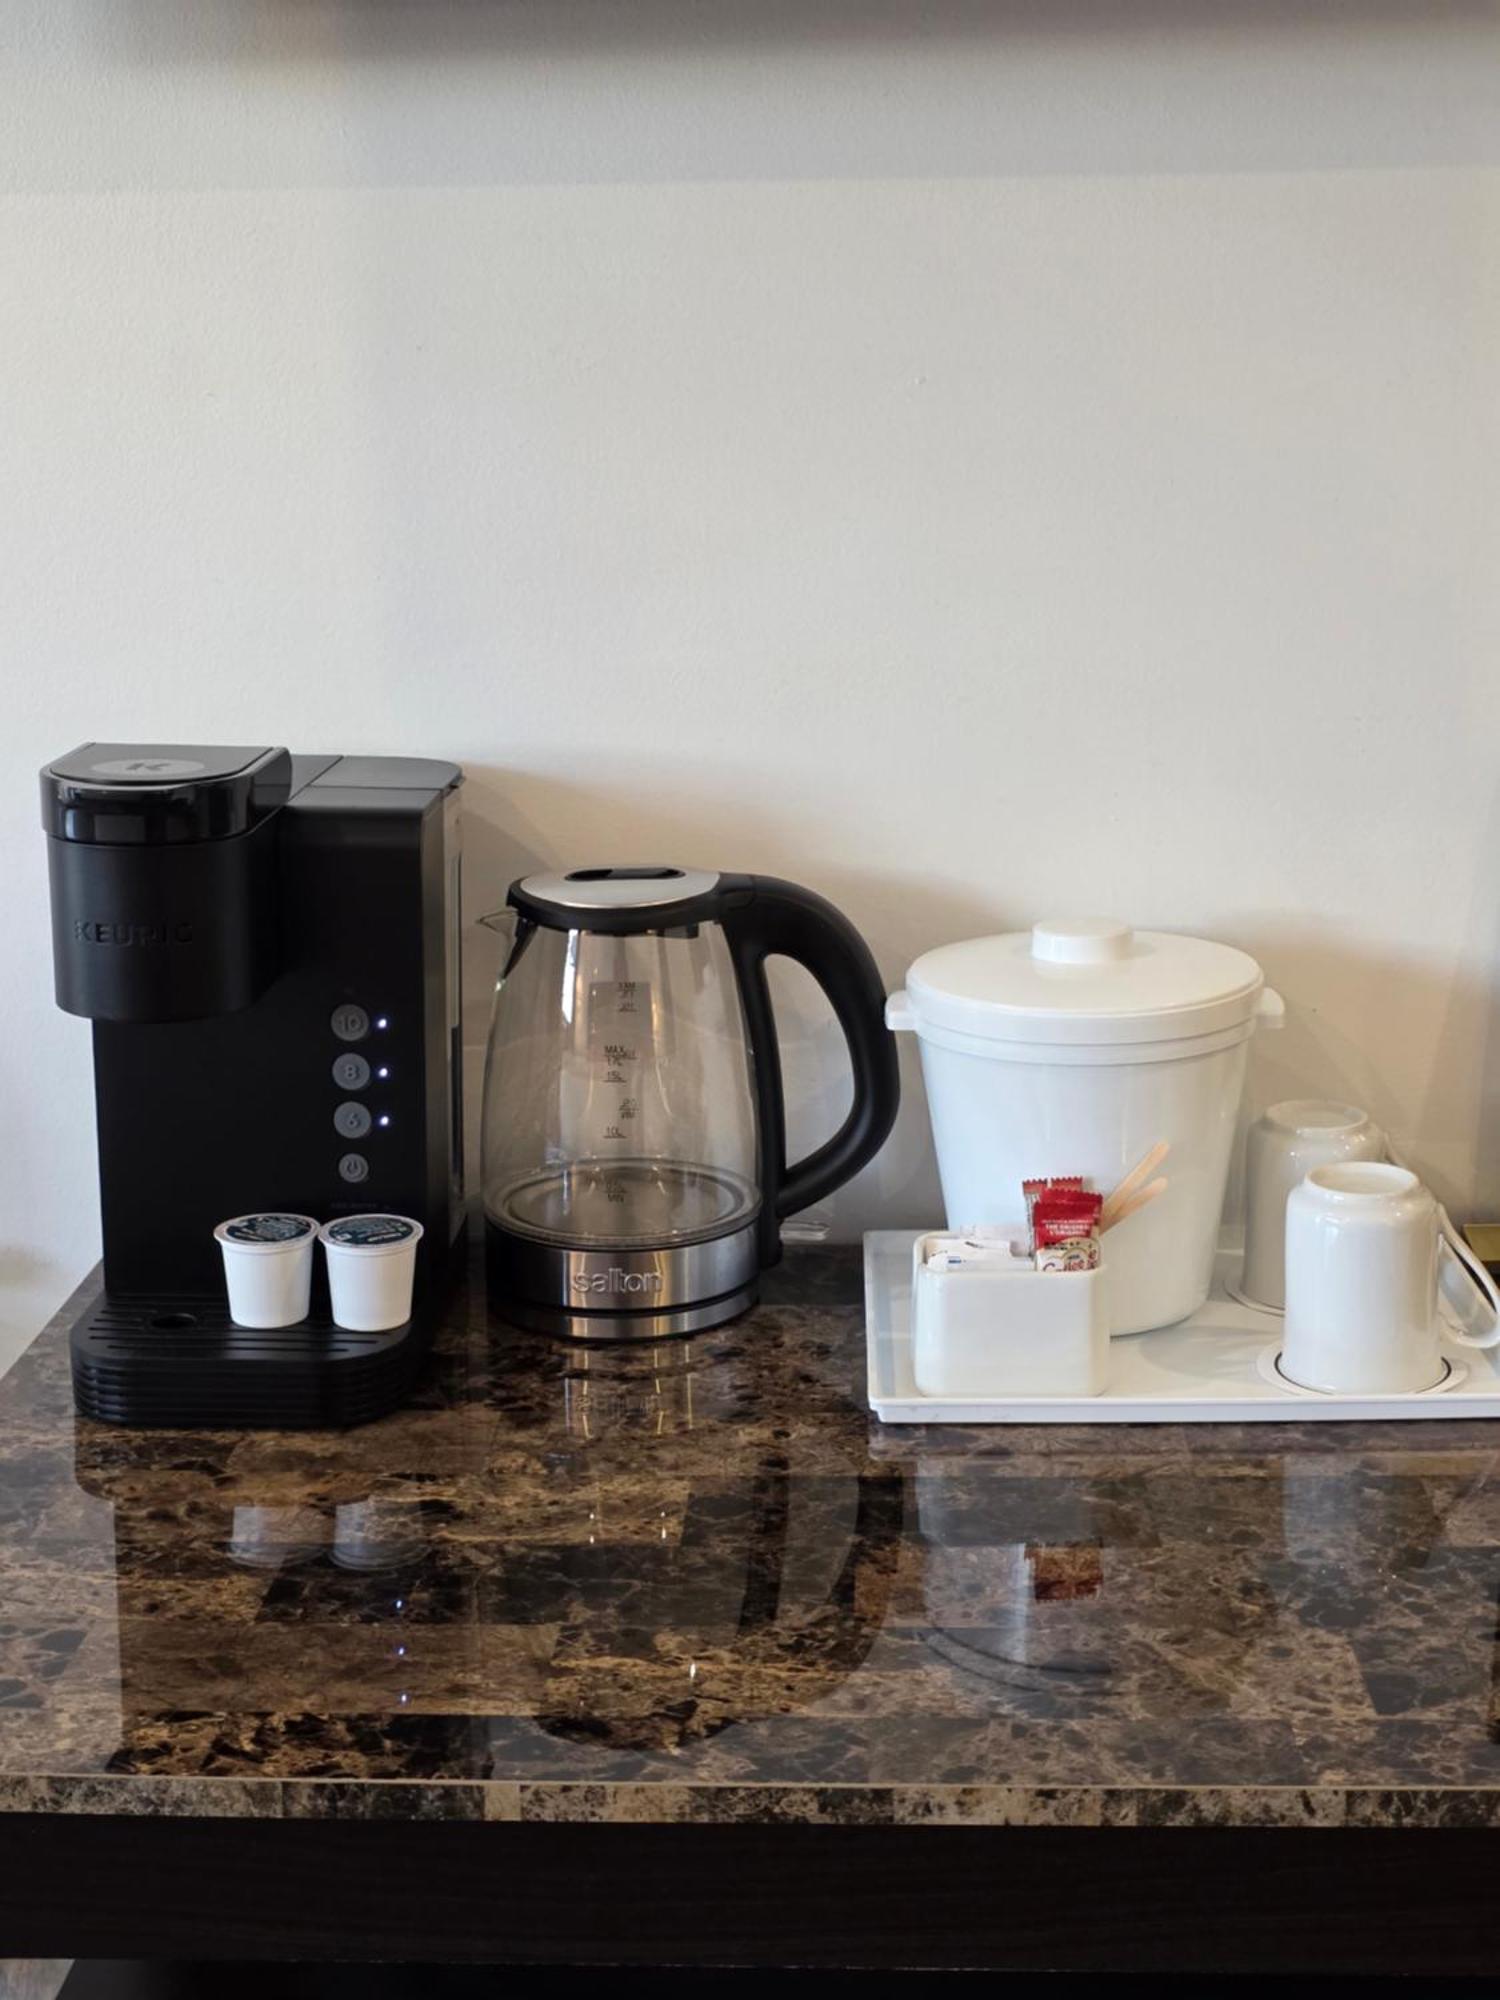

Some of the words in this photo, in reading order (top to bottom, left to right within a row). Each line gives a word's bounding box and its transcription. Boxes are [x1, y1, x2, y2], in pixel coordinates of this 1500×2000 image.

[125, 761, 172, 773] K
[73, 919, 193, 943] KEURIG
[604, 1045, 625, 1054] MAX
[344, 1062, 359, 1080] 8
[574, 1266, 662, 1292] salton
